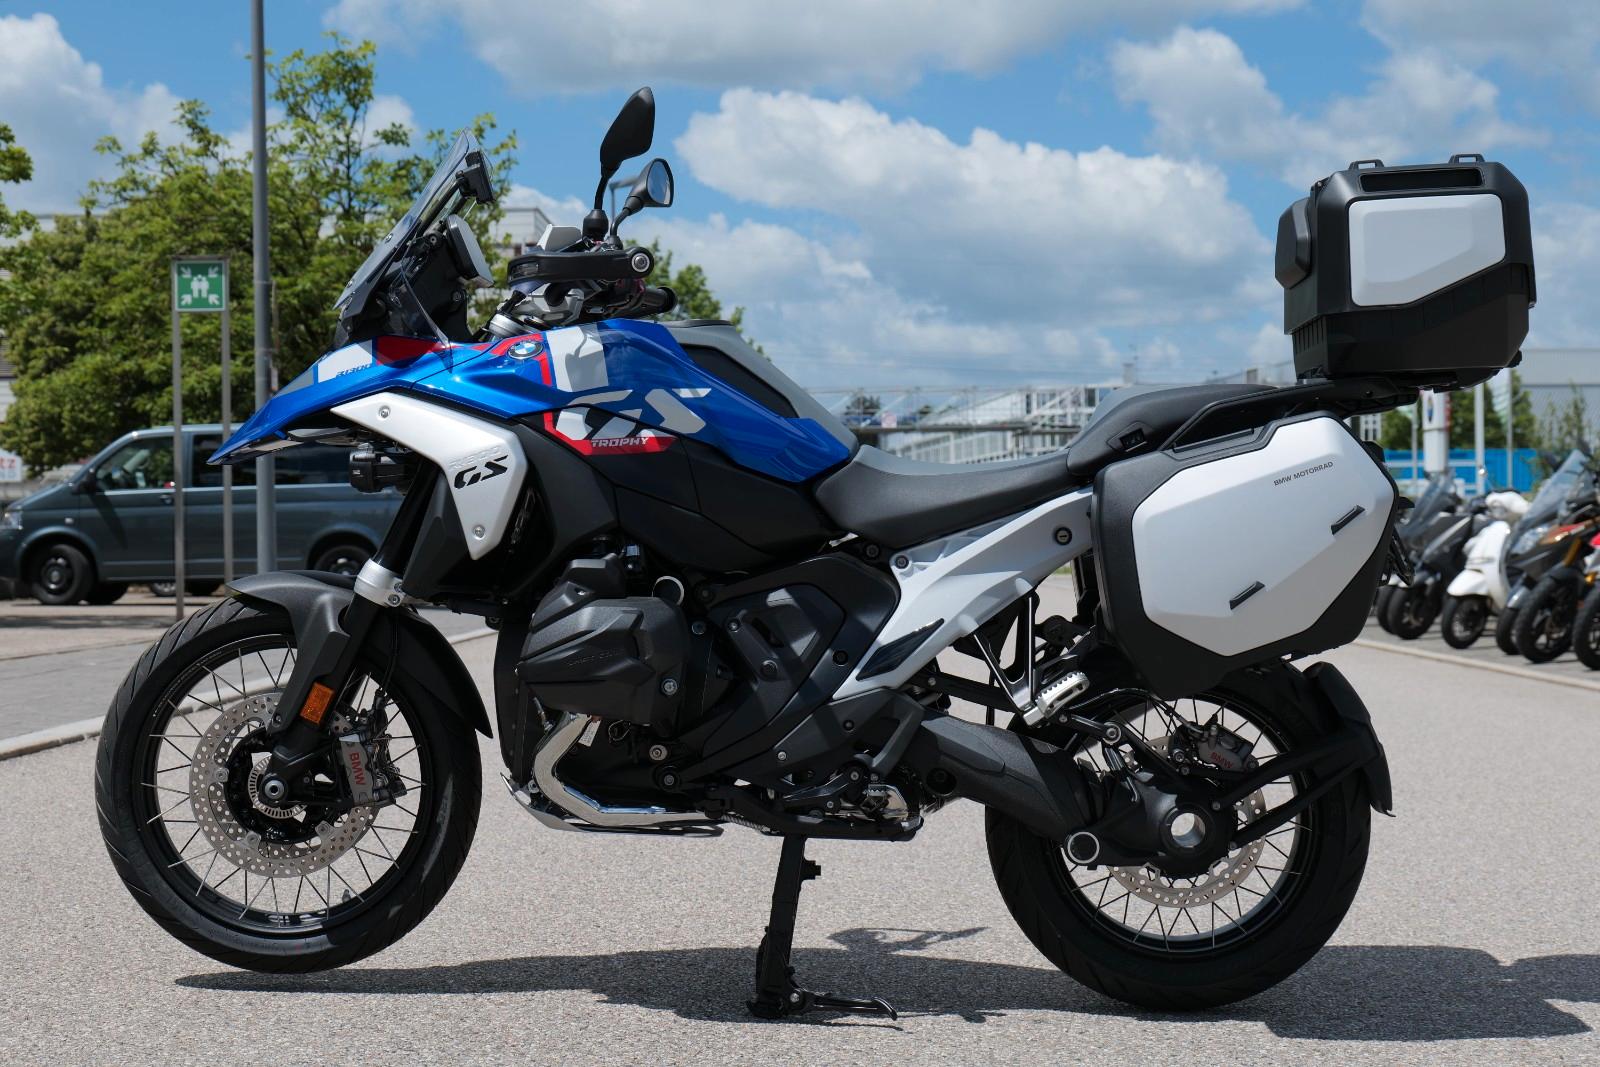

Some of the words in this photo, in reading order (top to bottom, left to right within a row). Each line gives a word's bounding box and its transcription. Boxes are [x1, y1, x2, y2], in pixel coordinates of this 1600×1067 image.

[590, 436, 650, 448] TROPHY
[454, 454, 508, 489] GS
[1273, 475, 1292, 486] BMW
[1293, 461, 1334, 480] MOTORRAD
[350, 752, 366, 785] BMW
[1210, 751, 1233, 769] BMW
